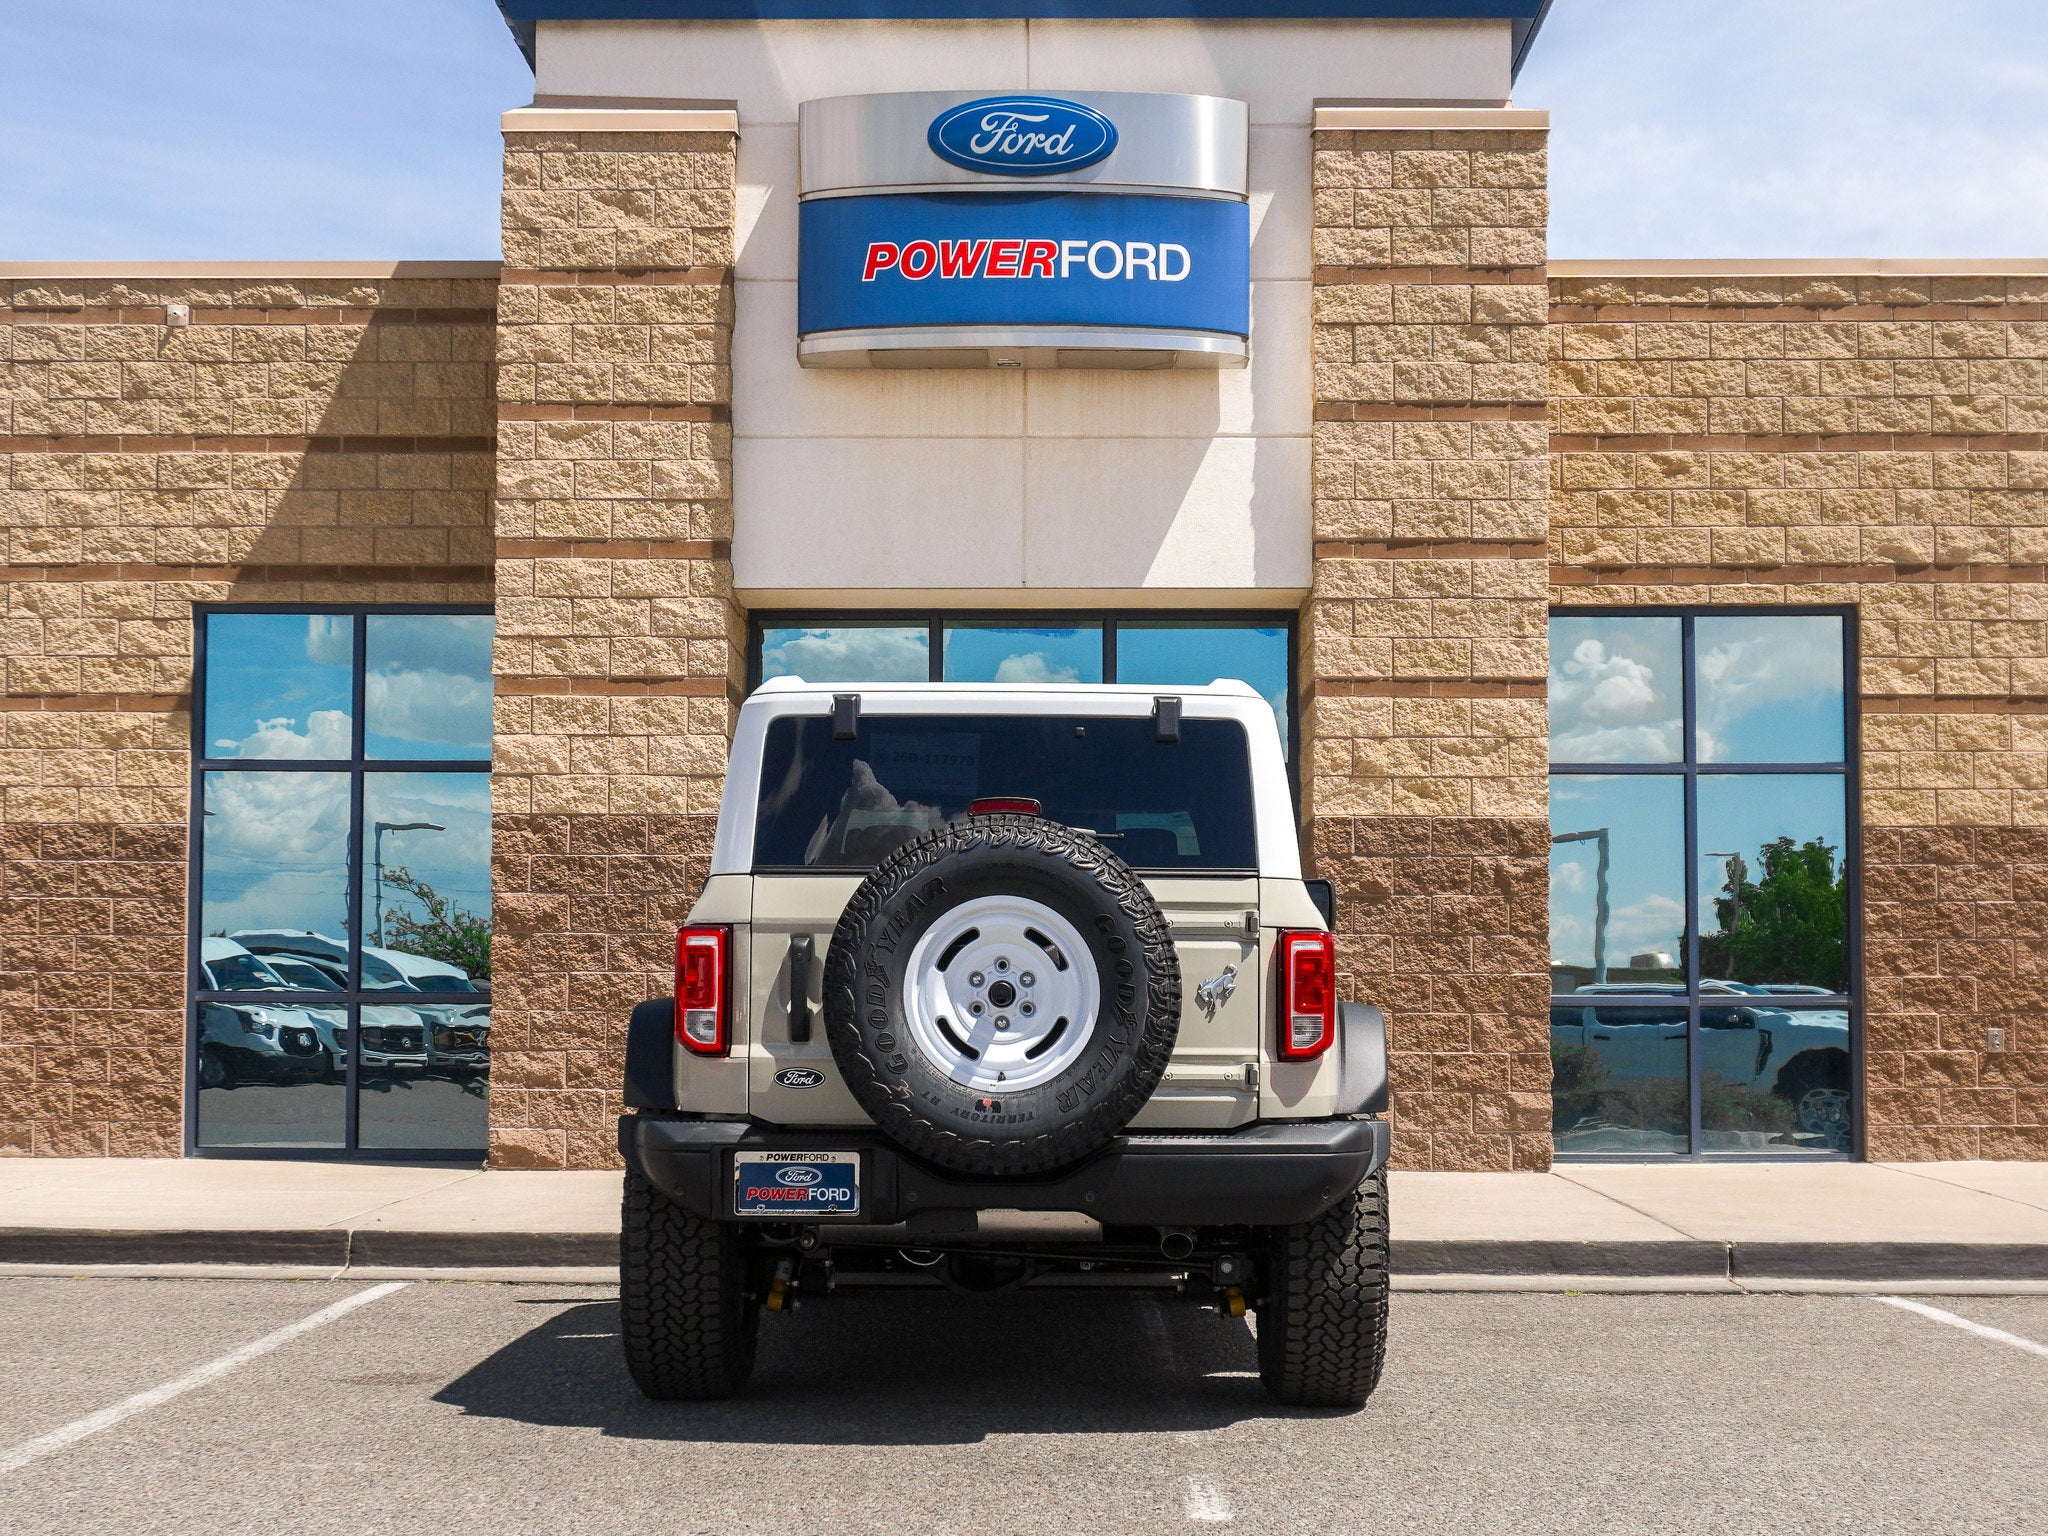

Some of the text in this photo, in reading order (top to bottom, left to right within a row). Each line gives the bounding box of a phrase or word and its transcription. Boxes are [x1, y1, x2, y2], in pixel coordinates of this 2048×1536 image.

[970, 111, 1076, 156] Ford
[862, 239, 1191, 282] POWERFORD
[783, 1070, 815, 1086] Ford
[950, 1107, 1035, 1124] TERRITORY
[766, 1153, 830, 1162] POWERFORD
[784, 1169, 813, 1183] Ford
[746, 1187, 850, 1201] POWERFORD
